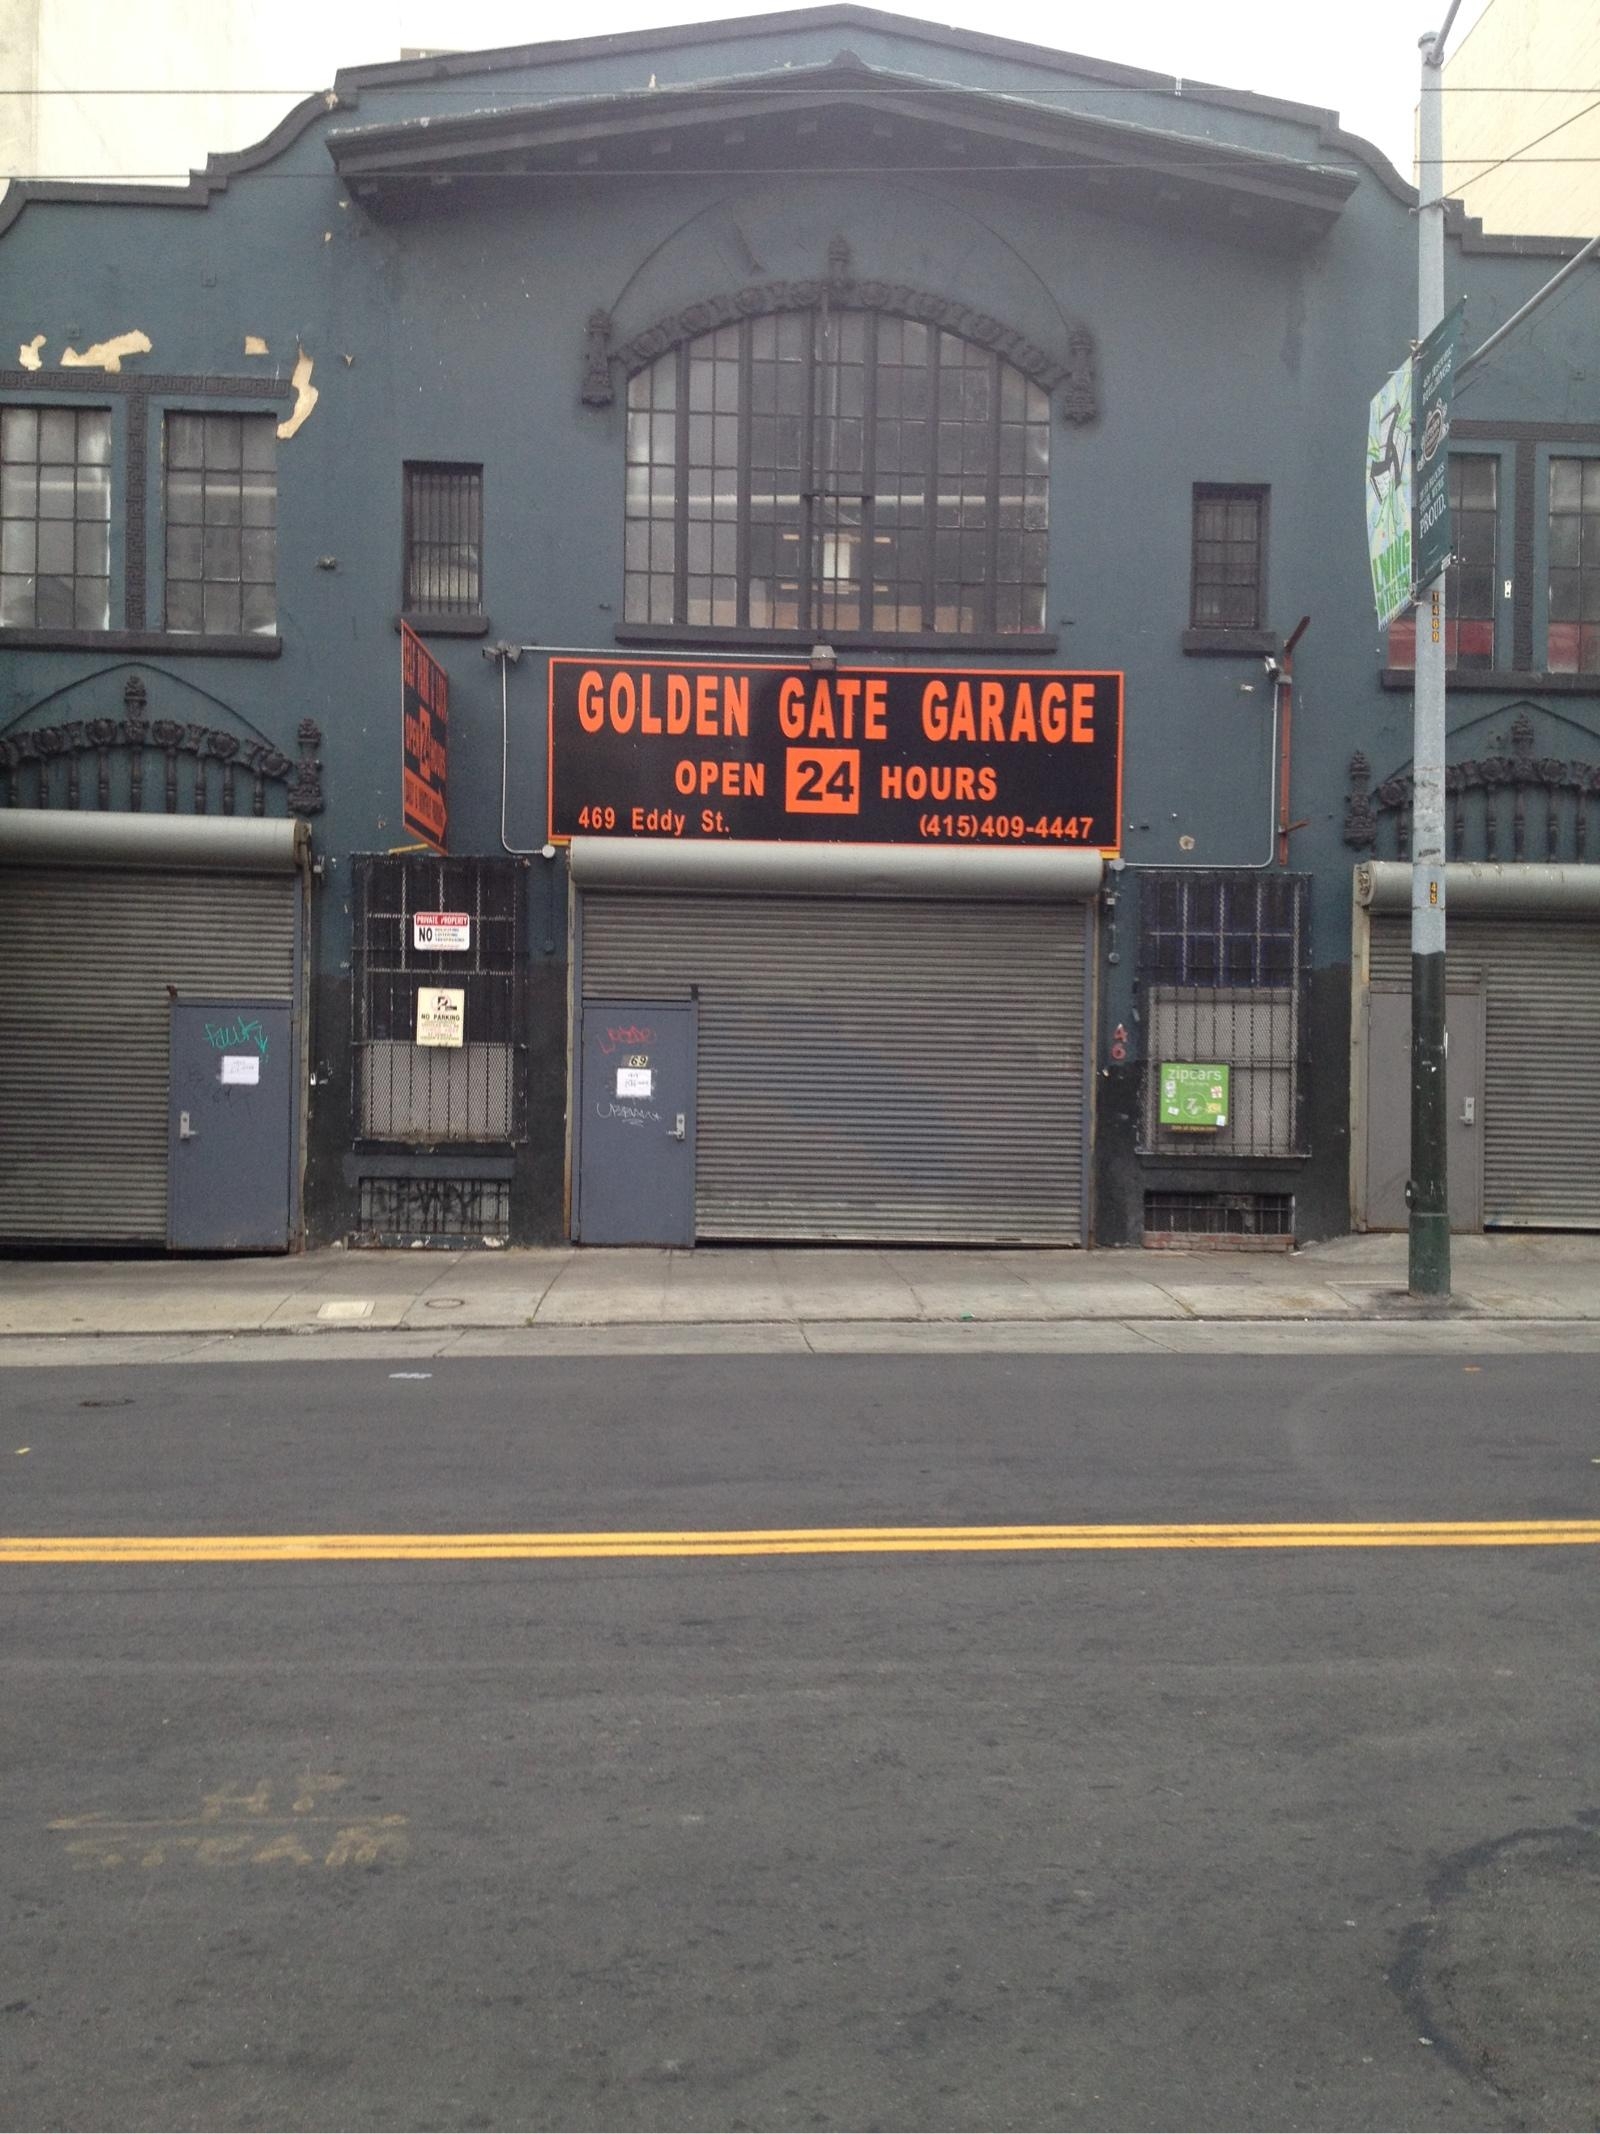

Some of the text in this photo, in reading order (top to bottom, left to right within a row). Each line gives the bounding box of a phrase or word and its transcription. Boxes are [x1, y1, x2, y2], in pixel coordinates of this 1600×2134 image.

[578, 670, 1096, 743] GOLDEN GATE GARAGE
[674, 760, 998, 803] OPEN 24 HOURS
[578, 807, 1094, 839] 469 Eddy St. (415)409-4447
[1430, 881, 1437, 904] 45
[416, 914, 468, 926] PRIVATE PROPERTY
[419, 927, 433, 942] NO
[421, 1013, 461, 1021] NO PARKING
[630, 1055, 648, 1066] 69
[1167, 1067, 1222, 1083] zipcars
